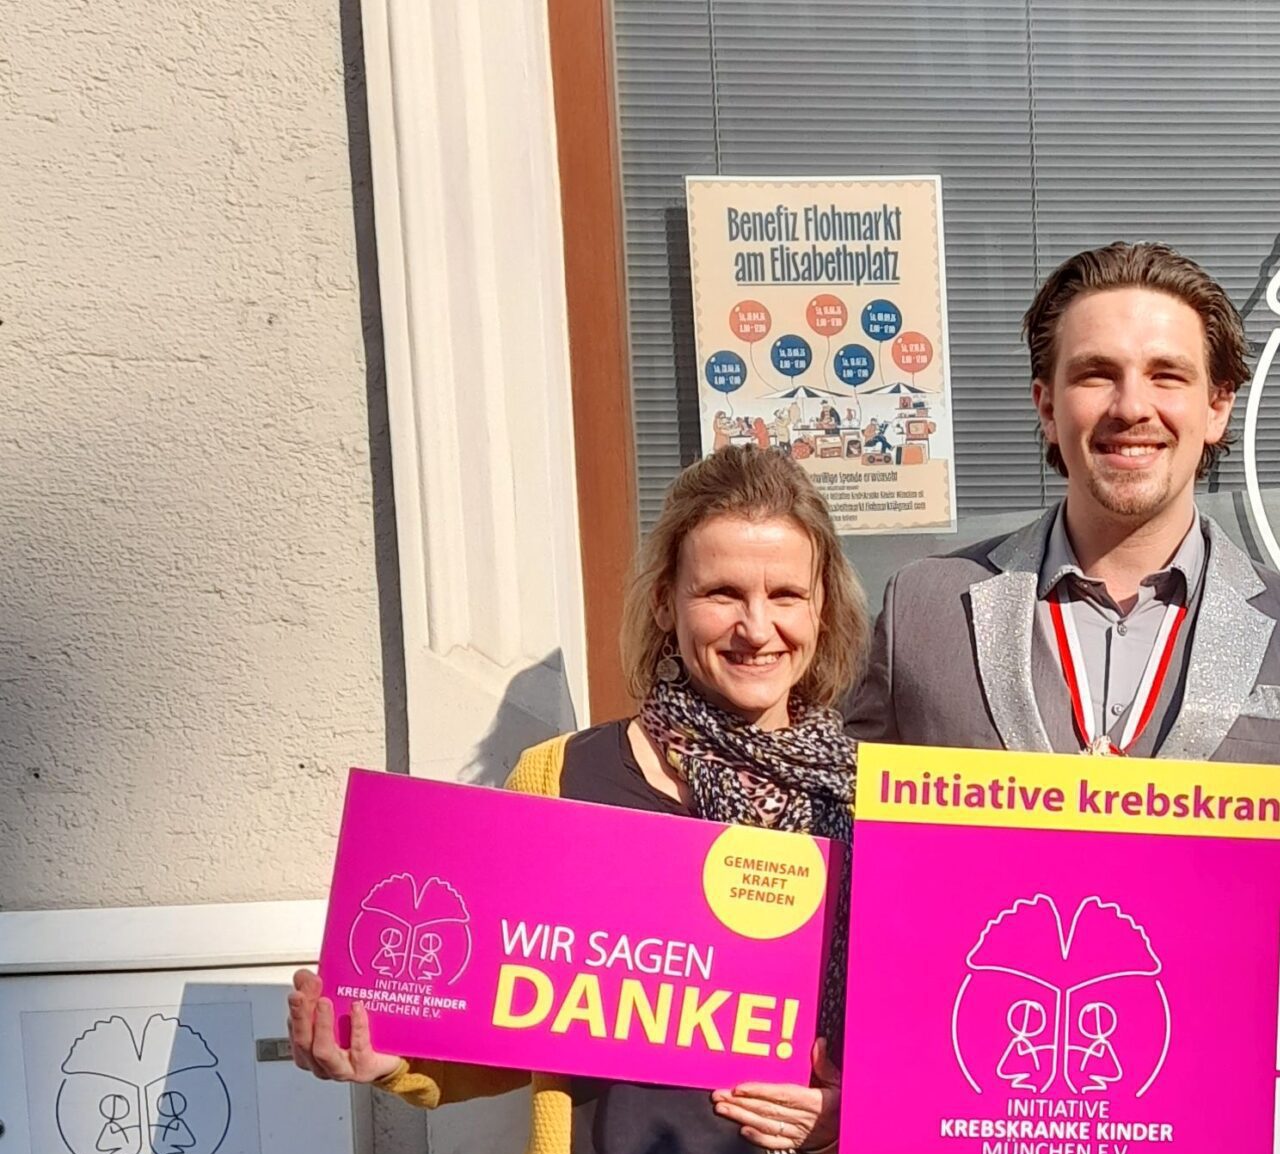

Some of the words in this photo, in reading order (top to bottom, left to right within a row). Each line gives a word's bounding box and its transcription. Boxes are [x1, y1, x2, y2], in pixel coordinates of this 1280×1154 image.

[728, 205, 798, 242] Benefiz
[804, 204, 902, 241] Flohmarkt
[735, 250, 765, 282] am
[771, 244, 901, 286] Elisabethplatz
[879, 771, 1065, 812] Initiative
[724, 855, 810, 878] GEMEINSAM
[742, 873, 788, 889] KRAFT
[729, 887, 795, 906] SPENDEN
[500, 918, 575, 965] WIR
[585, 930, 714, 980] SAGEN
[337, 986, 420, 1005] KREBSKRANKE
[423, 996, 467, 1010] KINDER
[375, 979, 433, 995] INITIATIVE
[422, 1007, 441, 1018] E.V.
[491, 964, 800, 1060] DANKE!
[1007, 1098, 1110, 1119] INITIATIVE
[940, 1118, 1090, 1140] KREBSKRANKE
[1096, 1122, 1174, 1142] KINDER
